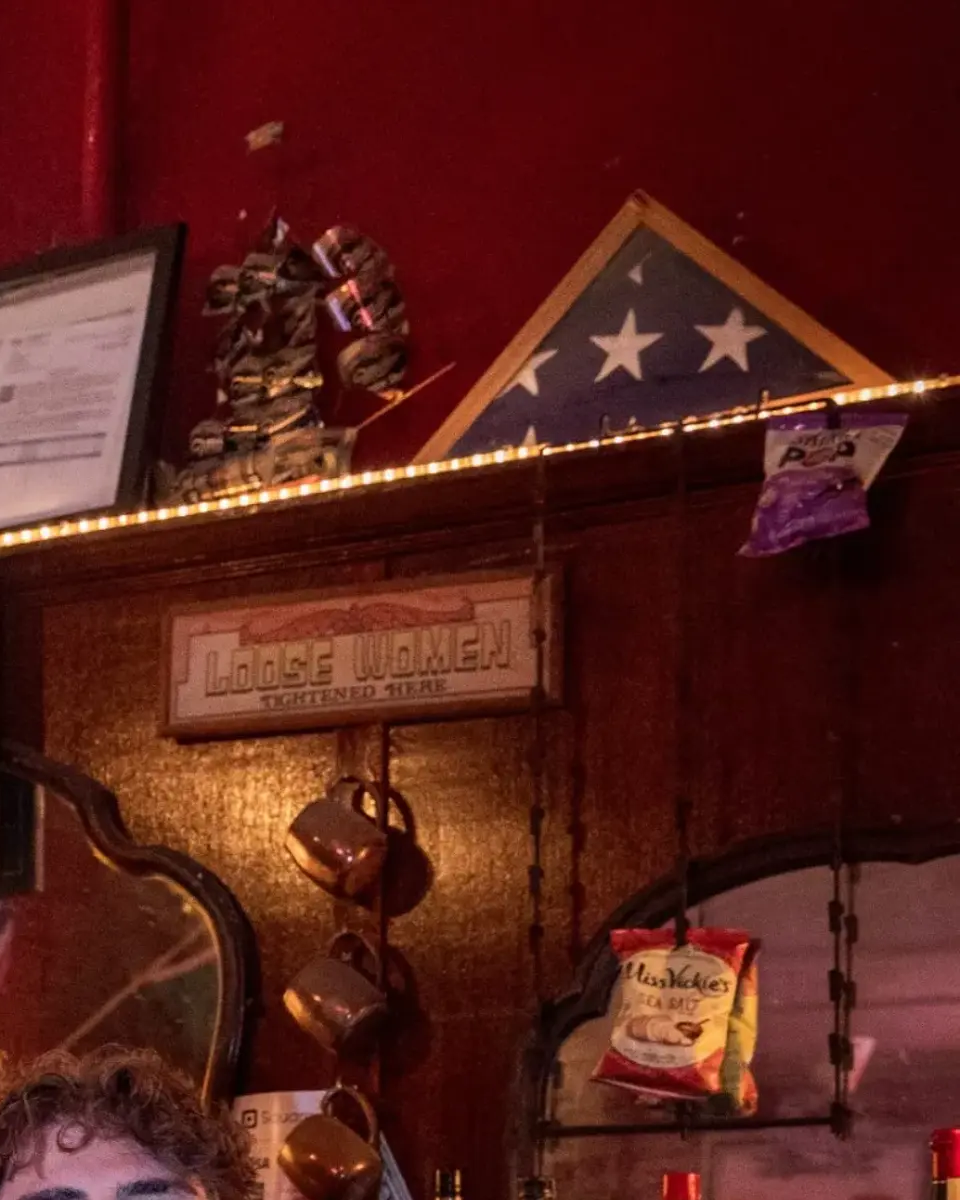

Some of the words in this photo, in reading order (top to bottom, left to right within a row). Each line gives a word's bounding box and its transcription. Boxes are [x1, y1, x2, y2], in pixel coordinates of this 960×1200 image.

[205, 638, 335, 697] LOOSE
[353, 619, 512, 682] WOMEN
[259, 684, 376, 711] TIGHTENED
[384, 677, 447, 698] HERE
[623, 961, 666, 989] Miss
